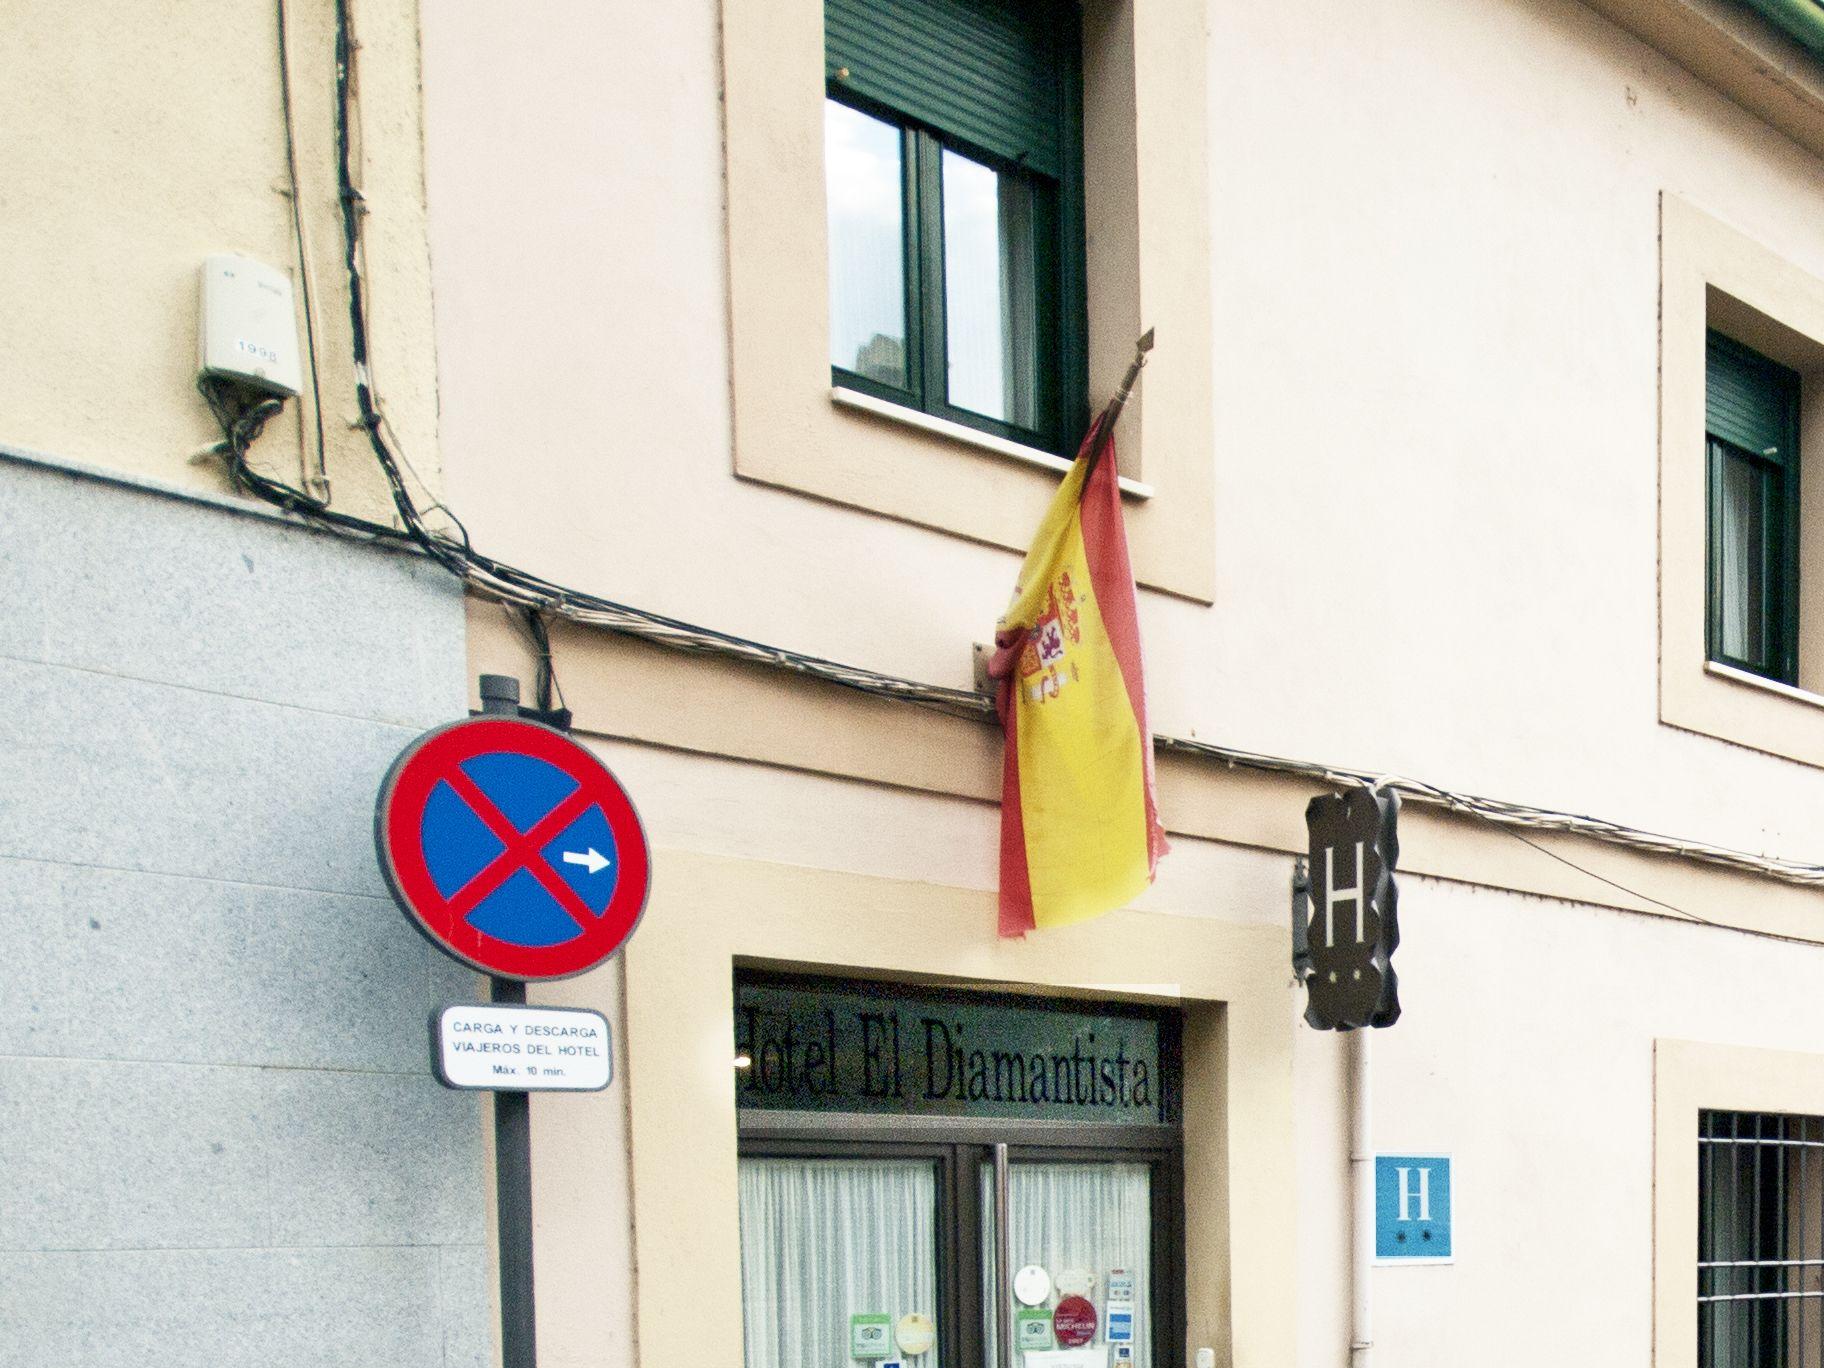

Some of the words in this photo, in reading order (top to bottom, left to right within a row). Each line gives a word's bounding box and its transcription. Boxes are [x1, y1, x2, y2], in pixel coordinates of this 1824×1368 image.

[1325, 841, 1364, 948] H
[453, 1021, 503, 1035] CARGA
[510, 1024, 518, 1034] Y
[525, 1024, 598, 1039] DESCARGA
[453, 1041, 521, 1055] VIAJEROS
[527, 1043, 552, 1056] DEL
[558, 1045, 600, 1058] HOTEL
[859, 1008, 901, 1098] El
[920, 1018, 1152, 1108] Diamantista
[527, 1066, 538, 1076] 10
[543, 1066, 567, 1077] min.
[1395, 1167, 1432, 1221] H
